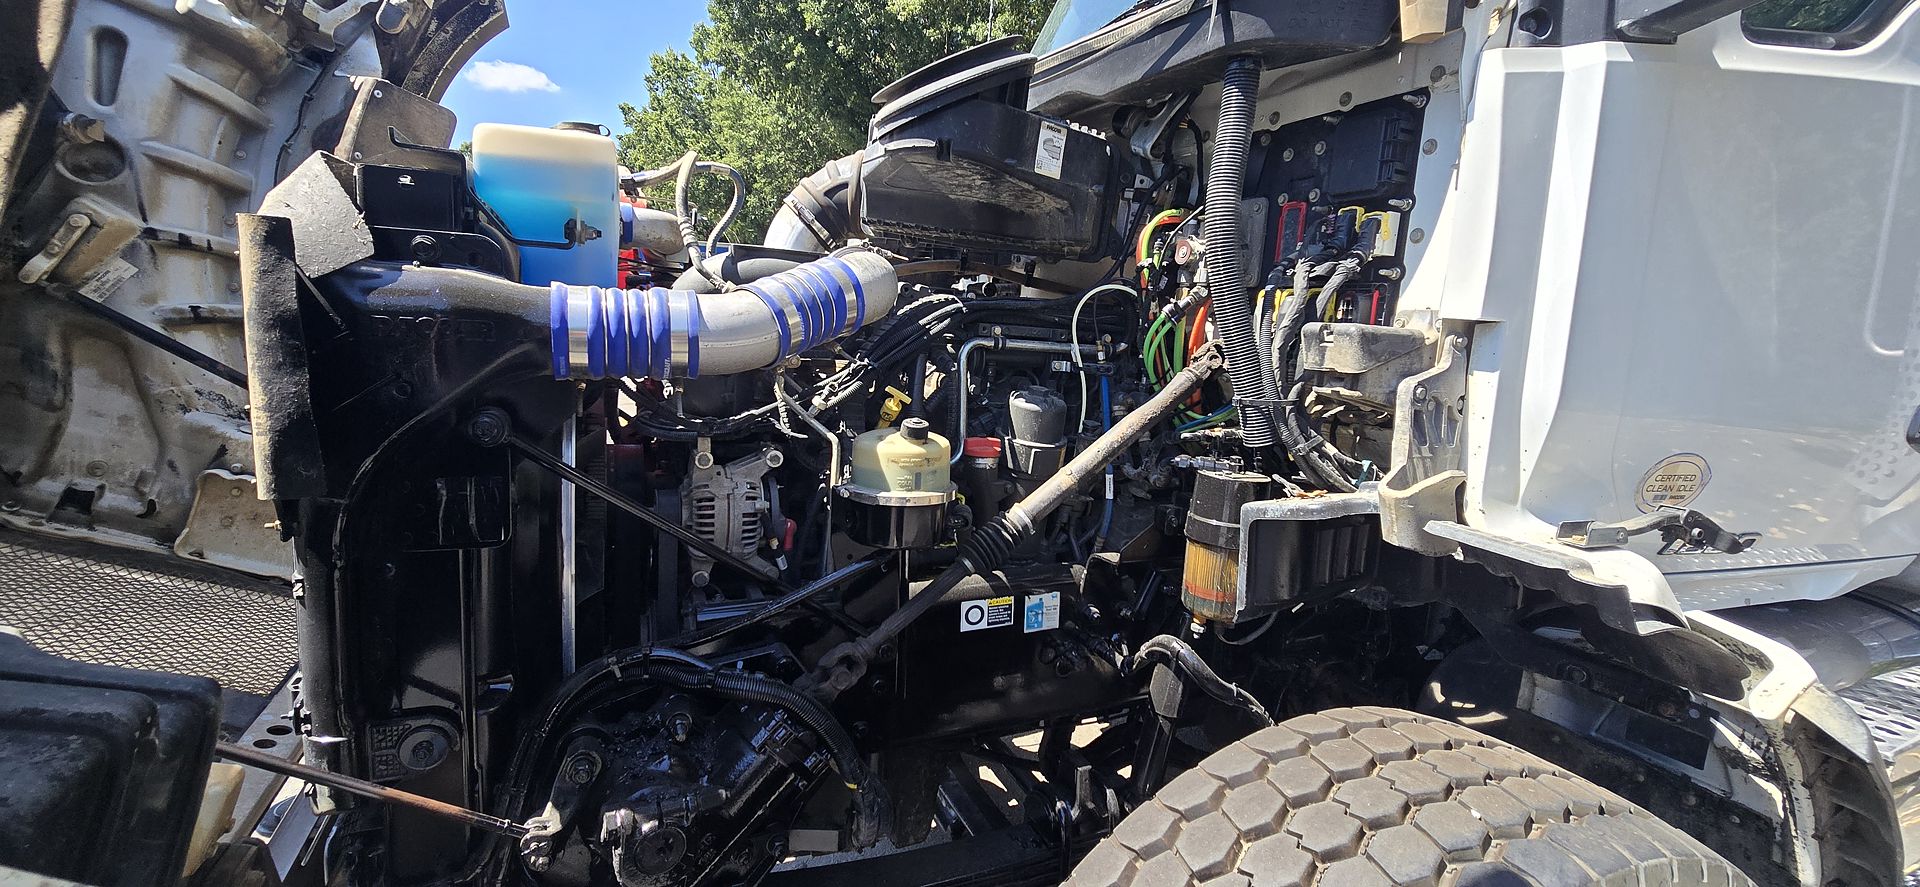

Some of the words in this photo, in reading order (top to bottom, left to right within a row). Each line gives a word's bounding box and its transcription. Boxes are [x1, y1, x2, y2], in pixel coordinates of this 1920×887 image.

[1654, 474, 1697, 482] CERTIFIED
[1646, 484, 1675, 493] CLEAN
[1677, 484, 1697, 492] IDLE
